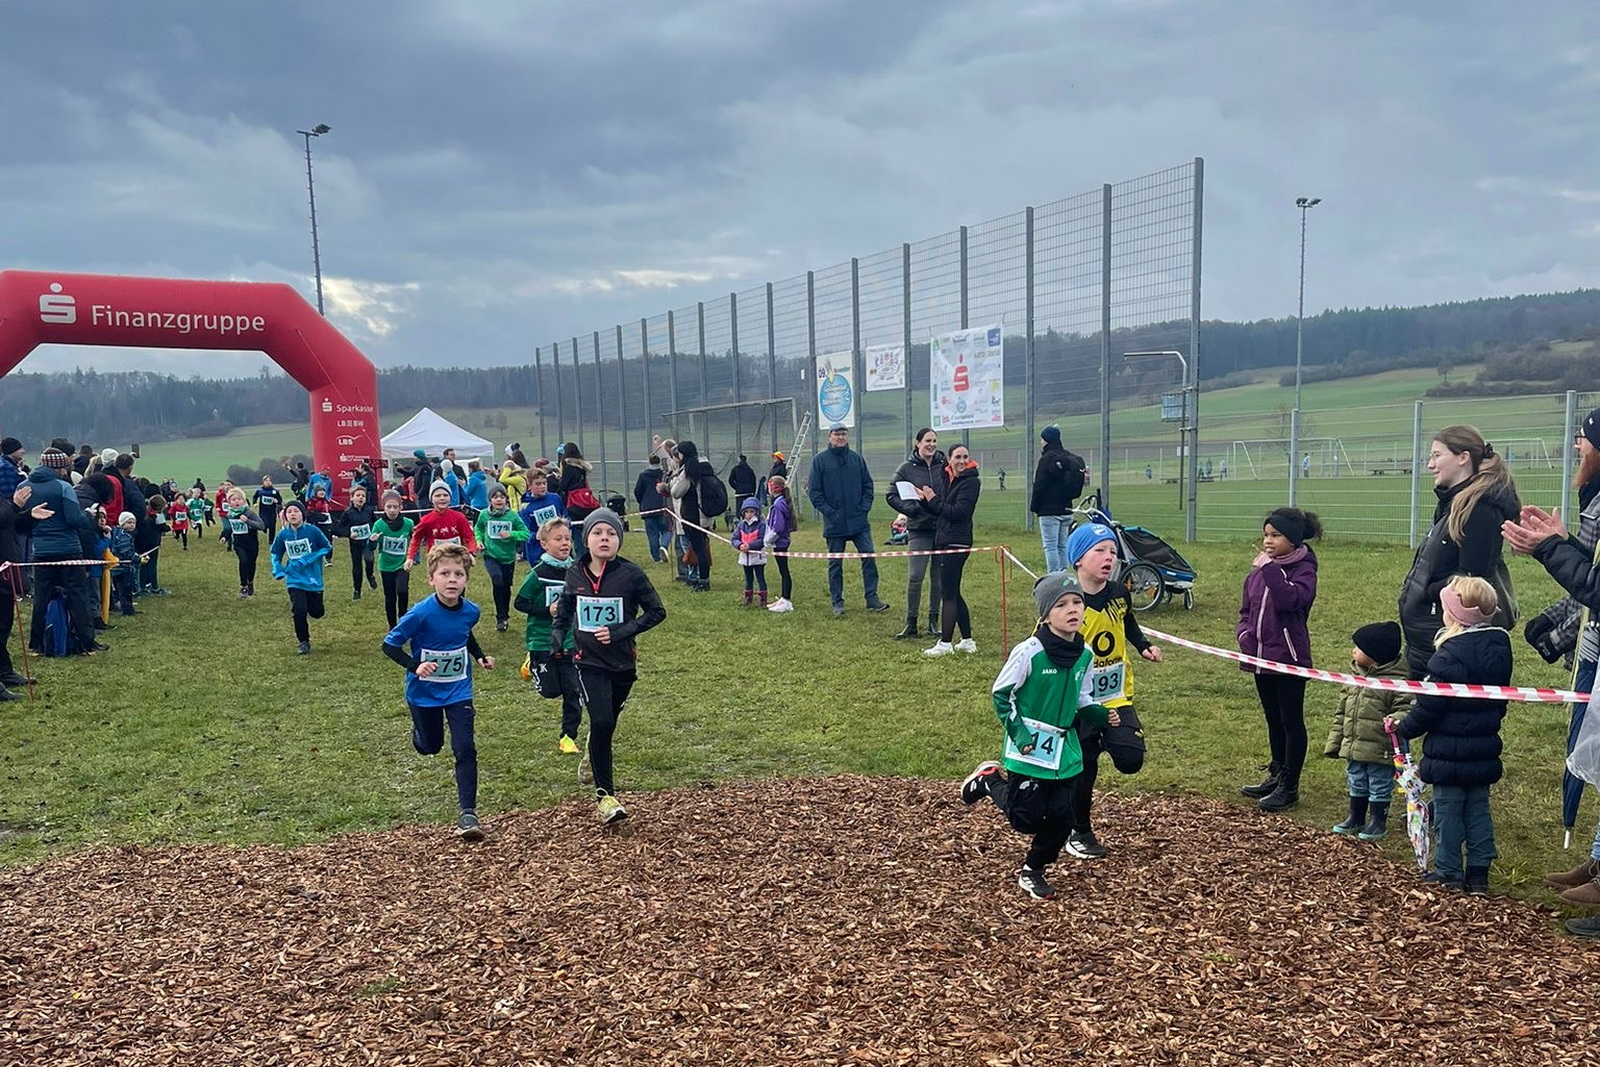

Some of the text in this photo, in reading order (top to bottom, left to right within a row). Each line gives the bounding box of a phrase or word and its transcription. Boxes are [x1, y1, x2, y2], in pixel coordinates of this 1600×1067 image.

[91, 304, 265, 335] Finanzgruppe
[336, 404, 374, 413] Sparkasse
[338, 438, 354, 446] LBS
[538, 508, 556, 520] 168
[288, 543, 308, 554] 162
[387, 540, 404, 550] 174
[583, 605, 616, 622] 173
[1097, 672, 1119, 693] 93
[1030, 731, 1054, 755] 14
